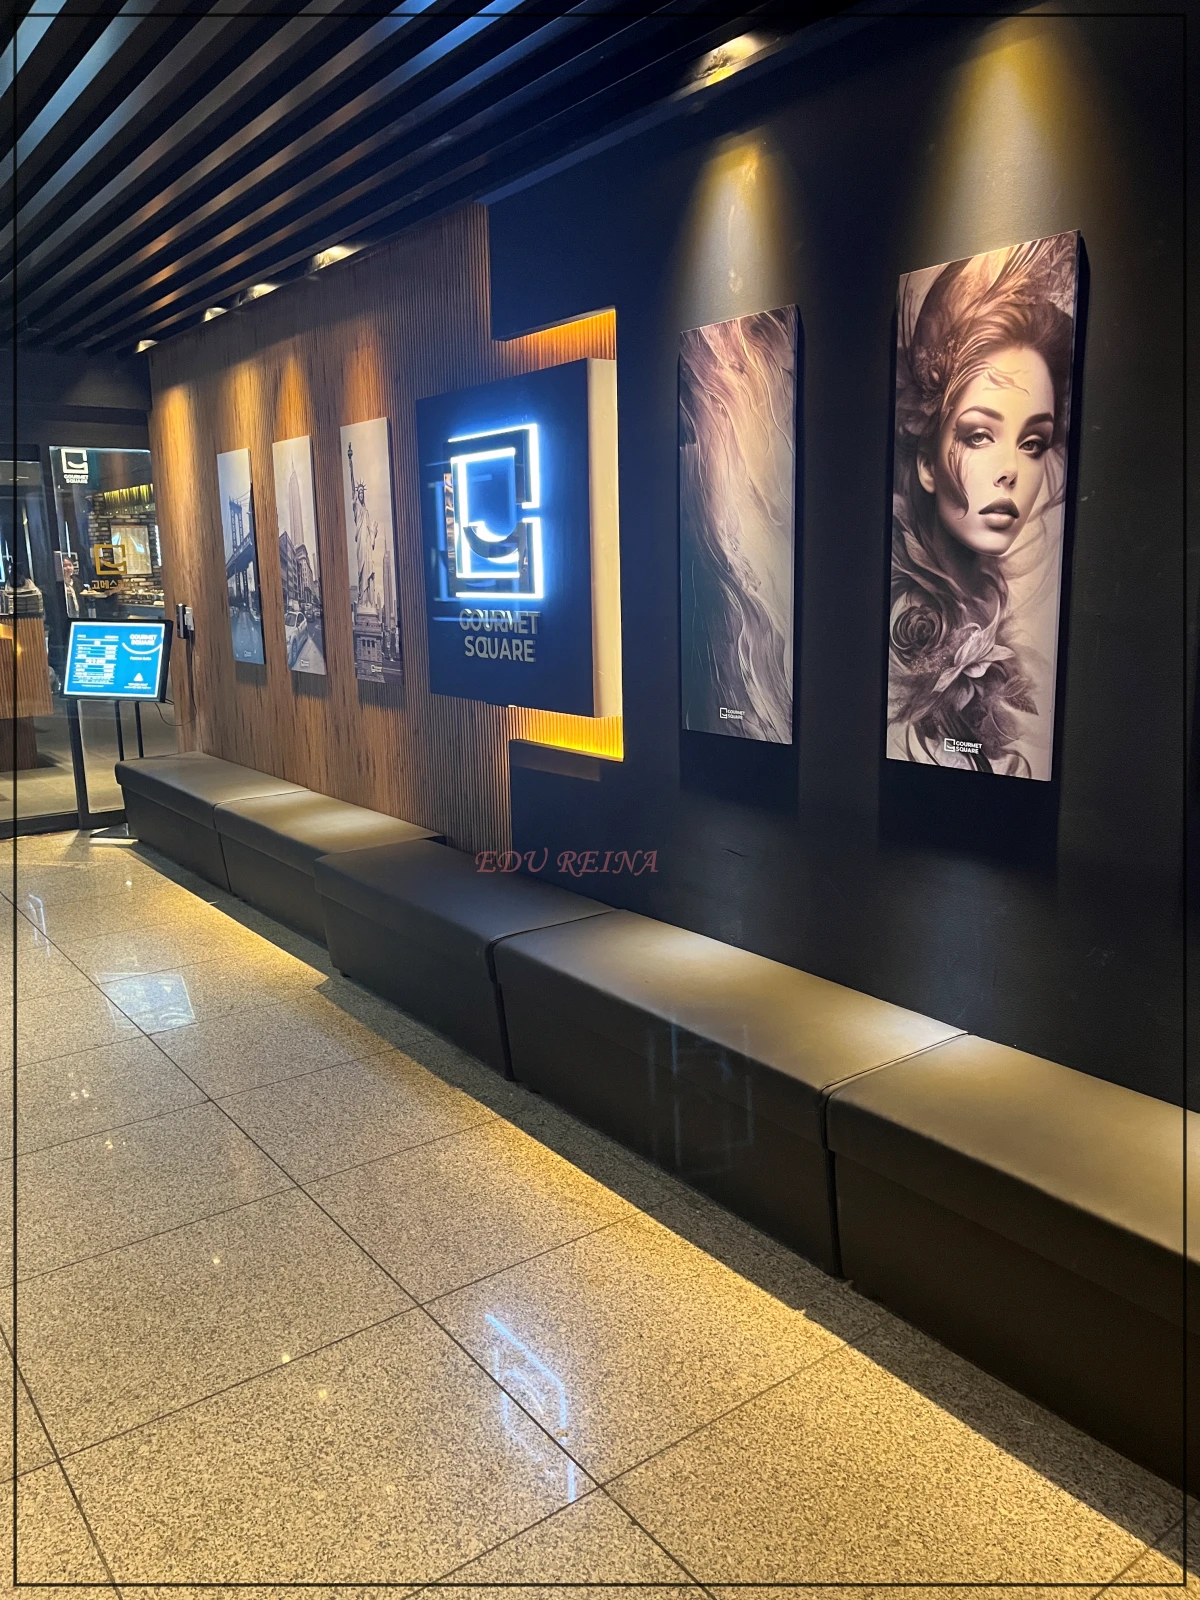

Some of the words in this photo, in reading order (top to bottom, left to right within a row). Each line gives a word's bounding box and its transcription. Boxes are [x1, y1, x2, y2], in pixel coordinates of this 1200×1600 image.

[459, 608, 541, 635] GOURMET
[464, 635, 536, 663] SQUARE
[955, 740, 983, 749] GOURMET
[955, 746, 979, 755] SQUARE
